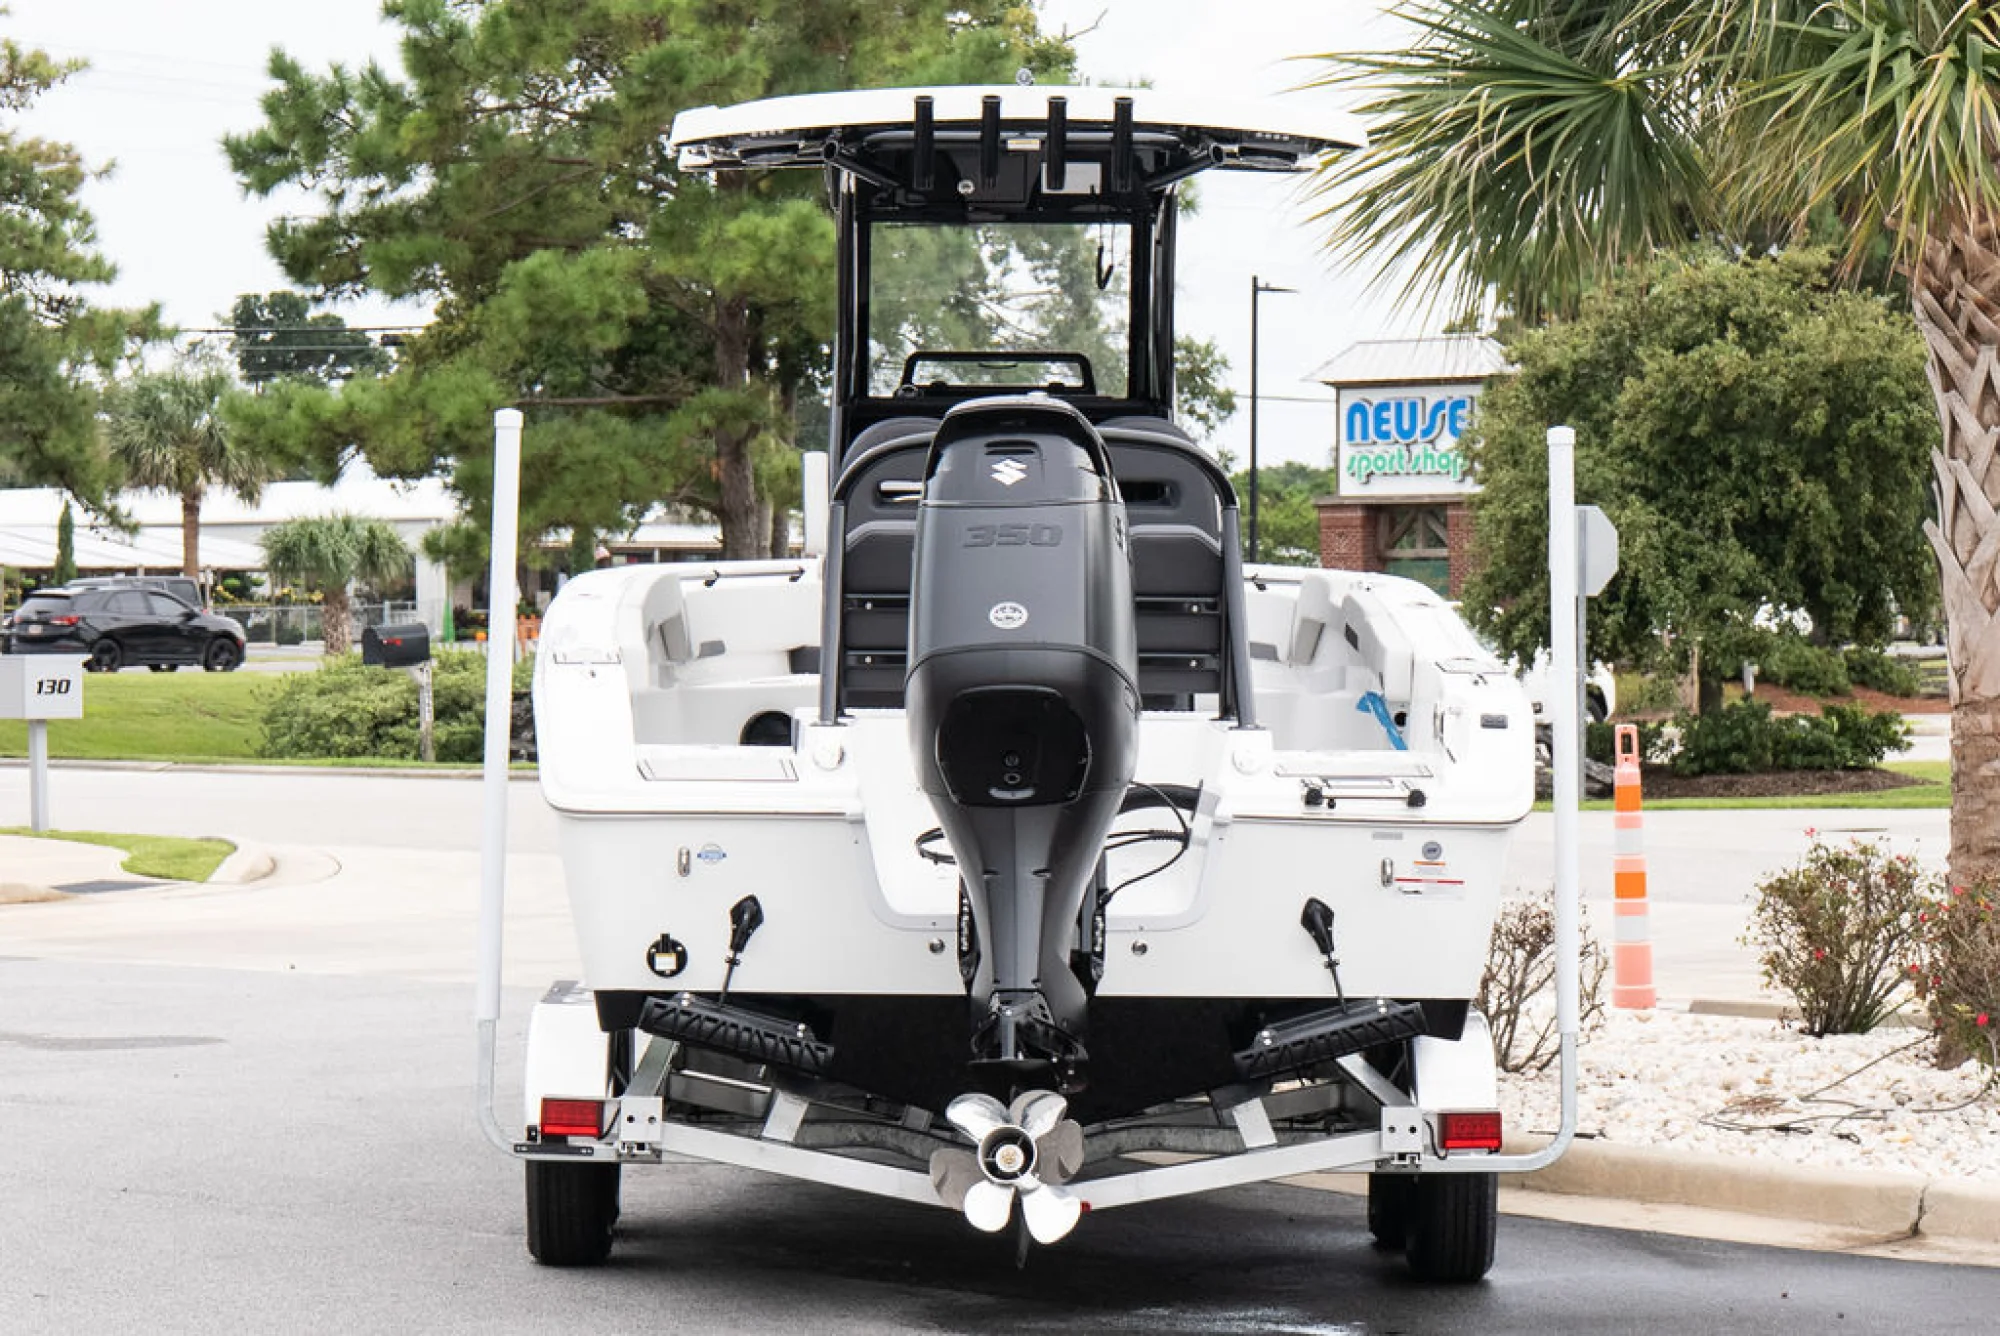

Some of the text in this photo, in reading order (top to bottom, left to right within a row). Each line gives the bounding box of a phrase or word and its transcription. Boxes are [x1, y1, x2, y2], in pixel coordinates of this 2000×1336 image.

[1347, 446, 1404, 481] sport
[963, 525, 1064, 548] 350
[36, 679, 71, 694] 130
